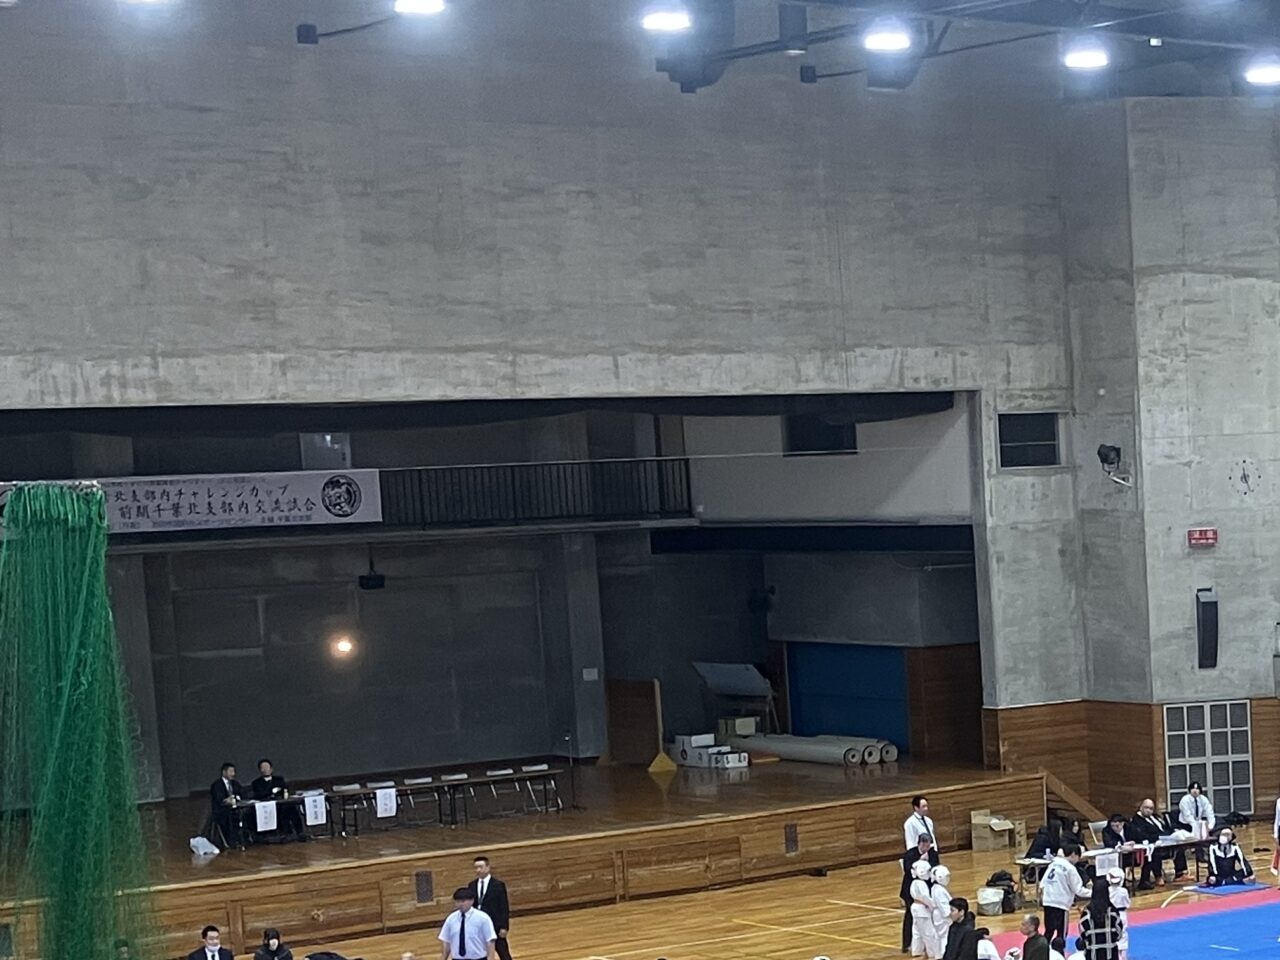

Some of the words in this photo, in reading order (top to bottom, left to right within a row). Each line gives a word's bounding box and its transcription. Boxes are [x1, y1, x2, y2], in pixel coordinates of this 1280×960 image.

[105, 483, 289, 503] 北支部内チャレンジカップ
